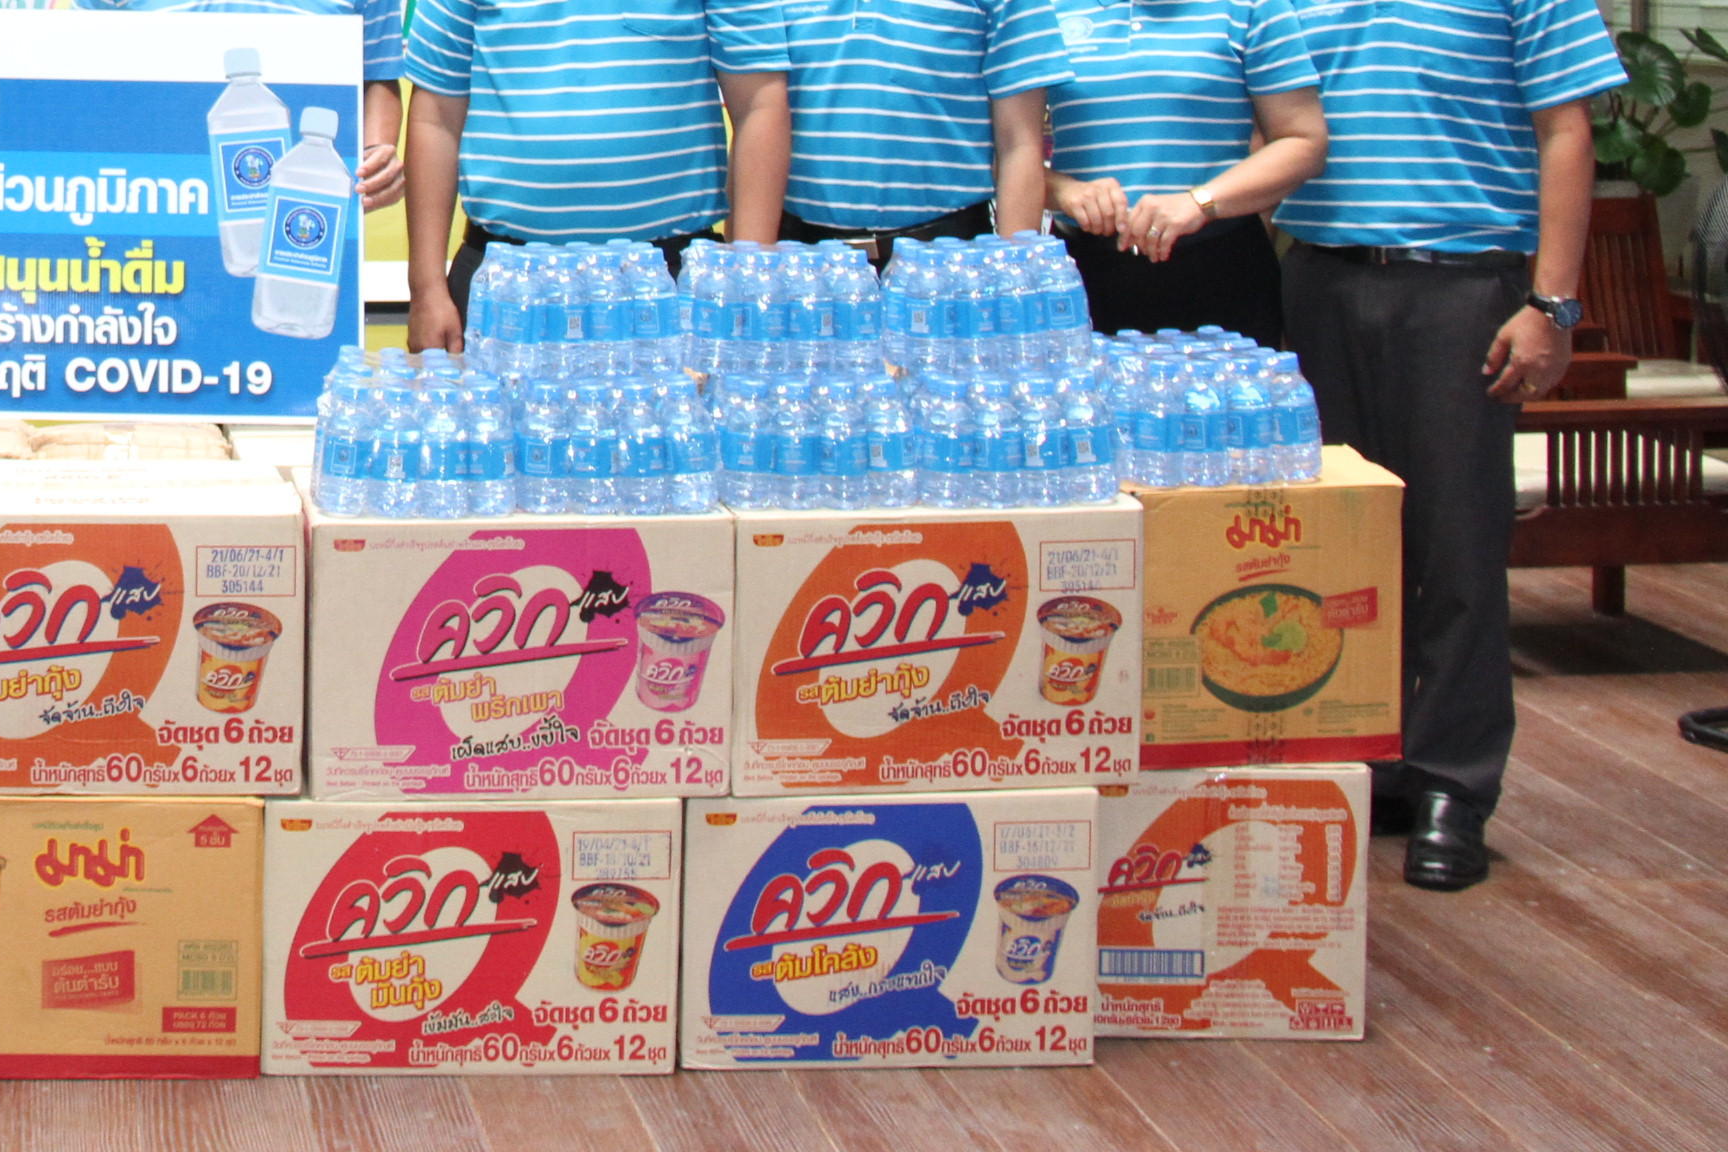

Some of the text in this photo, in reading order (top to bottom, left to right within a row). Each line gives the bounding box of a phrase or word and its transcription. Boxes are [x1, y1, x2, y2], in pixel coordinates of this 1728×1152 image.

[64, 357, 273, 396] COVID-19
[211, 549, 285, 563] 21/06/21-4/1
[221, 580, 265, 594] 305144
[418, 574, 571, 664] ควิก
[798, 568, 949, 657] ควิก
[157, 718, 293, 752] จัดชุด 6 ถ้วย
[590, 719, 723, 754] จัดชุด 6 ถ้วย
[1001, 712, 1061, 744] จัดชุด
[1065, 710, 1084, 735] 6
[1089, 711, 1132, 735] ถ้วย
[34, 827, 145, 887] มาม่า
[1107, 844, 1183, 887] ควิก
[44, 896, 137, 923] รสต้มยำกุ้ง
[326, 854, 479, 942] ควิก
[750, 849, 903, 935] ควิก
[534, 998, 667, 1030] จัดชุด 6 ถ้วย
[956, 990, 1088, 1021] จัดชุด 6 ถ้วย
